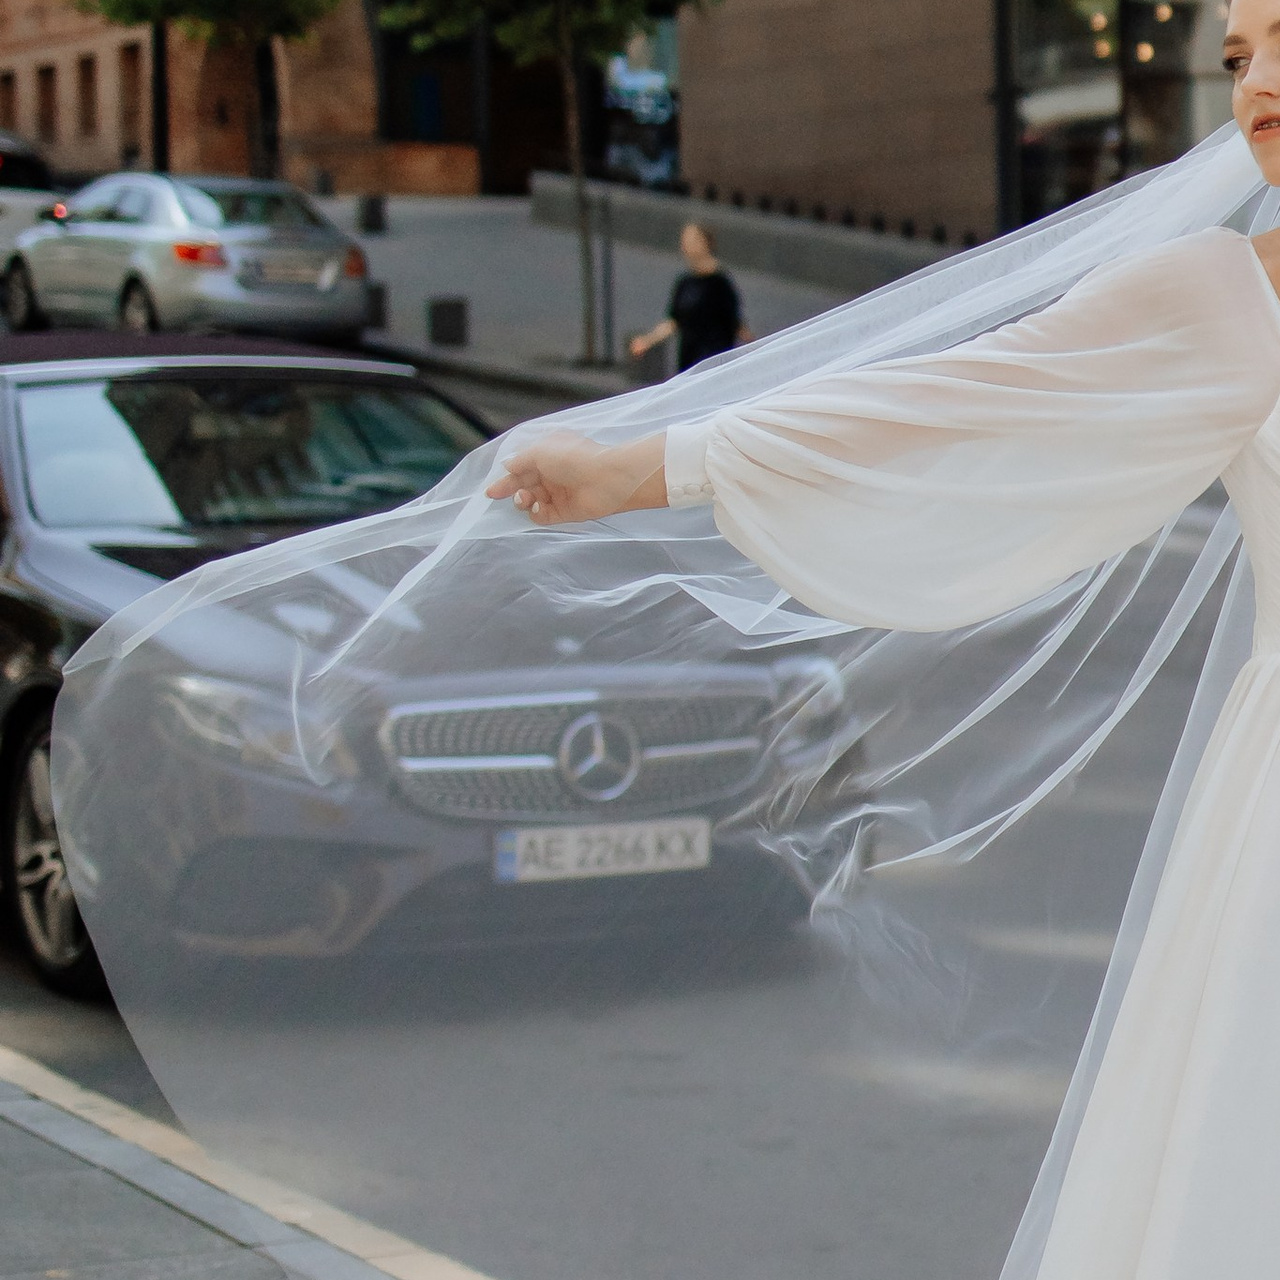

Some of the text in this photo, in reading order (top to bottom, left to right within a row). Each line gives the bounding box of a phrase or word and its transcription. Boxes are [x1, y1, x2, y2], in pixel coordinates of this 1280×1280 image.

[521, 828, 700, 871] AE 2266 KX
